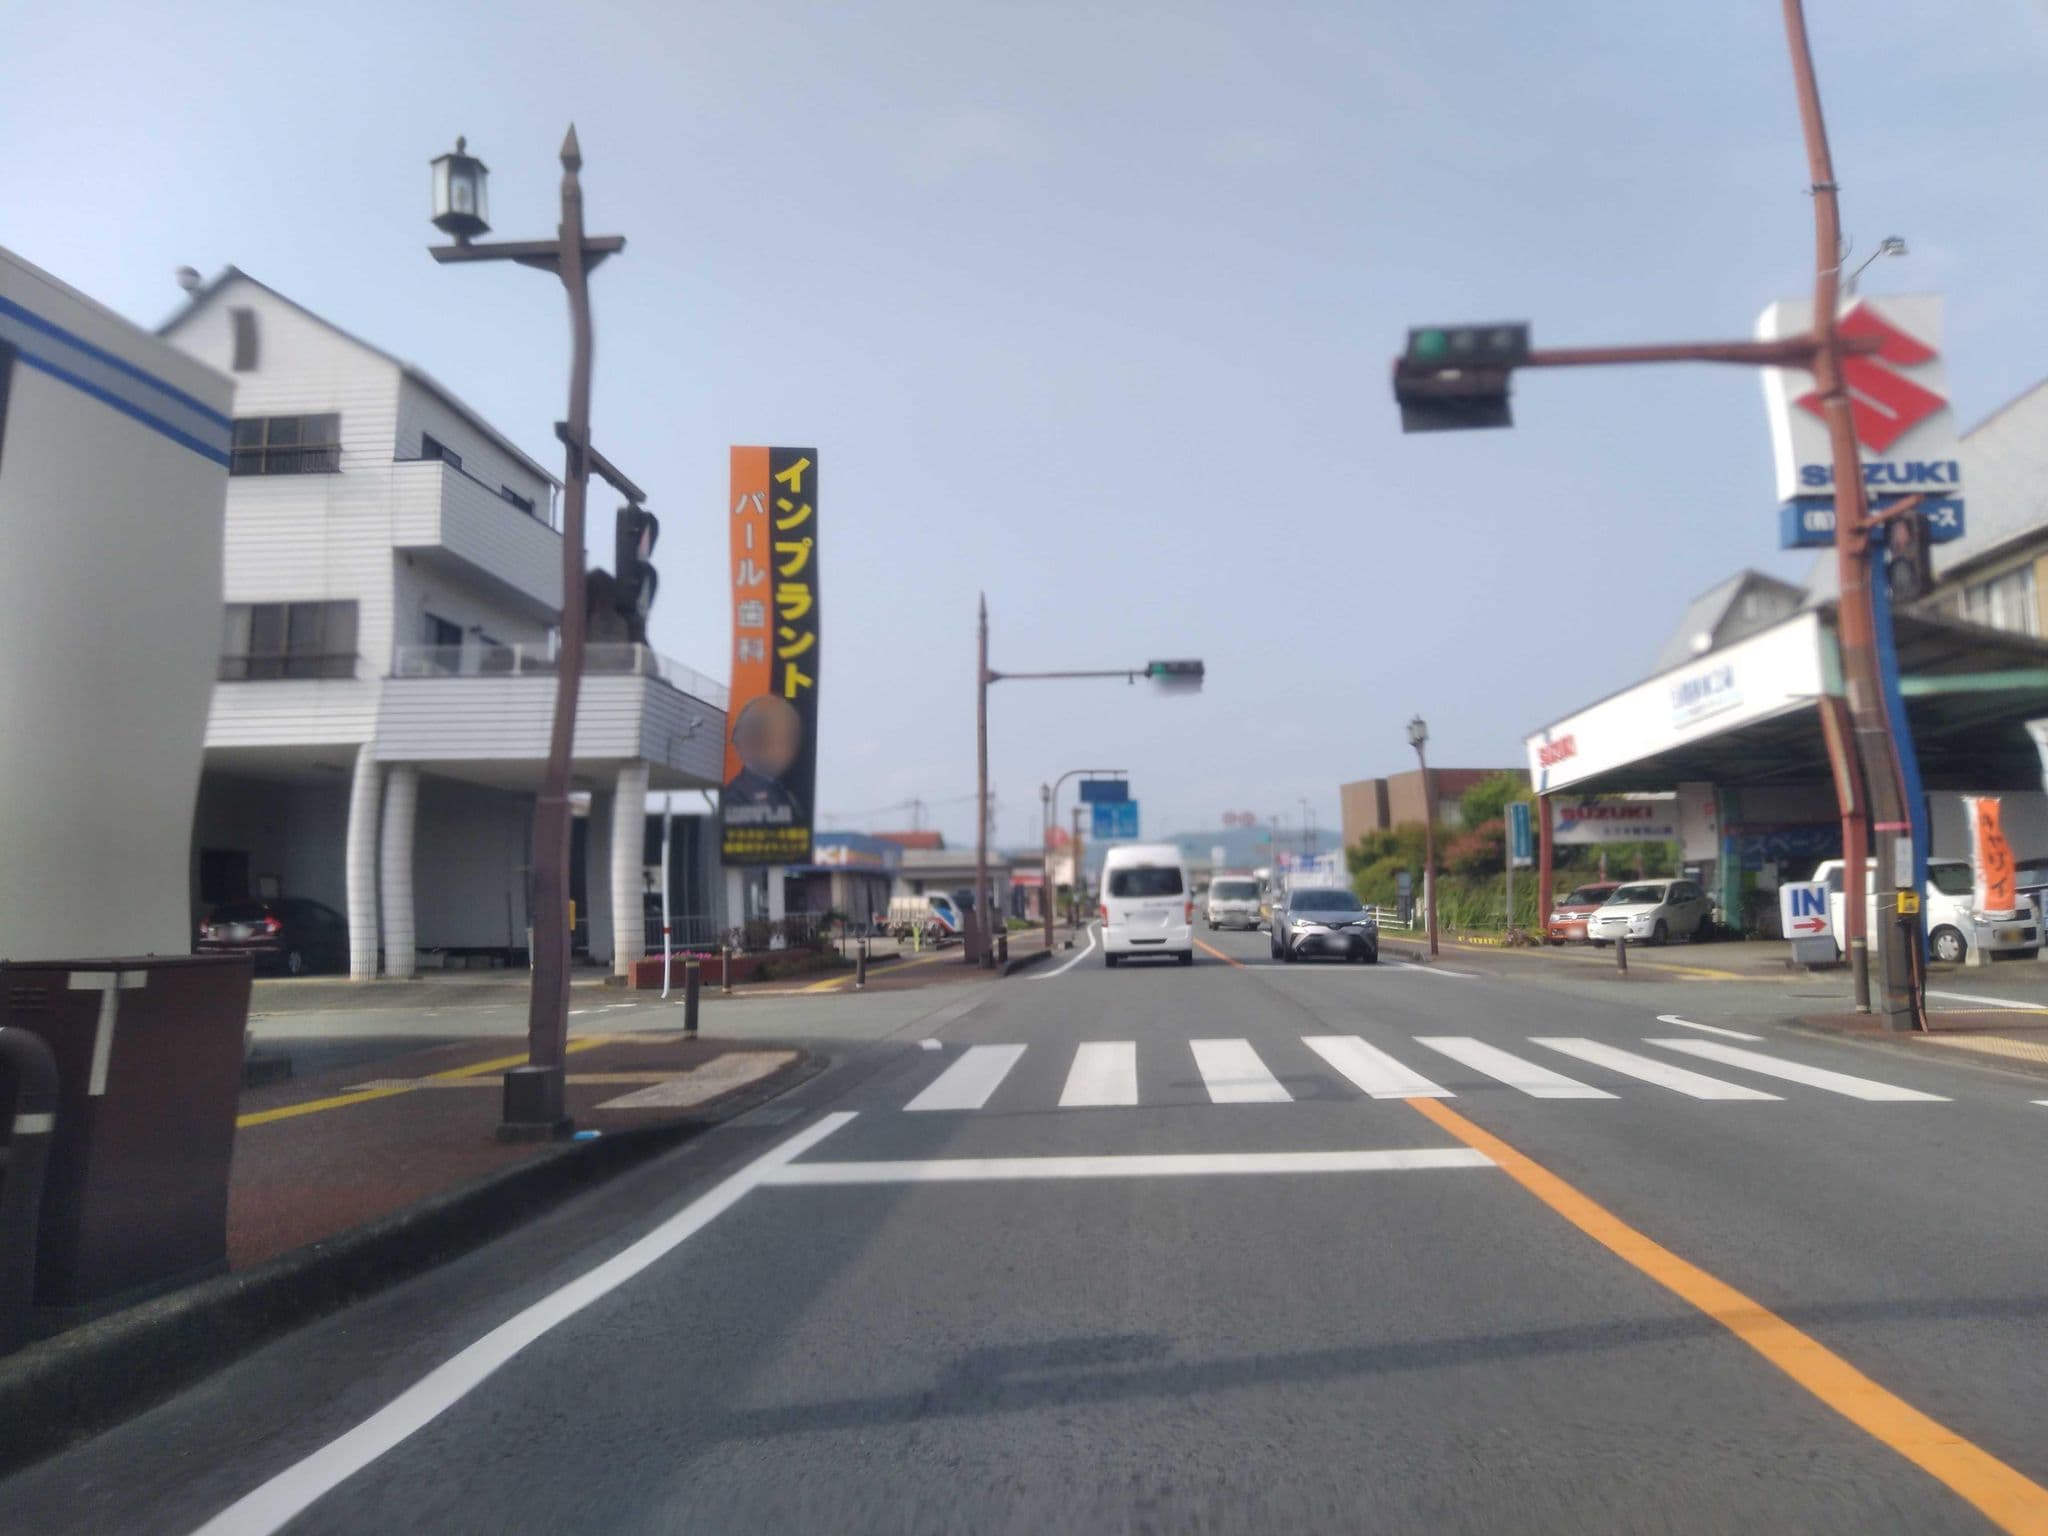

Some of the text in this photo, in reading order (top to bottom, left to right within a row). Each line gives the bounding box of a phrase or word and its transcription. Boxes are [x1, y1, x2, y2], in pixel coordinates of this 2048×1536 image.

[1801, 461, 1959, 486] SZUKI
[775, 457, 815, 698] インプラント
[1791, 888, 1826, 916] IN
